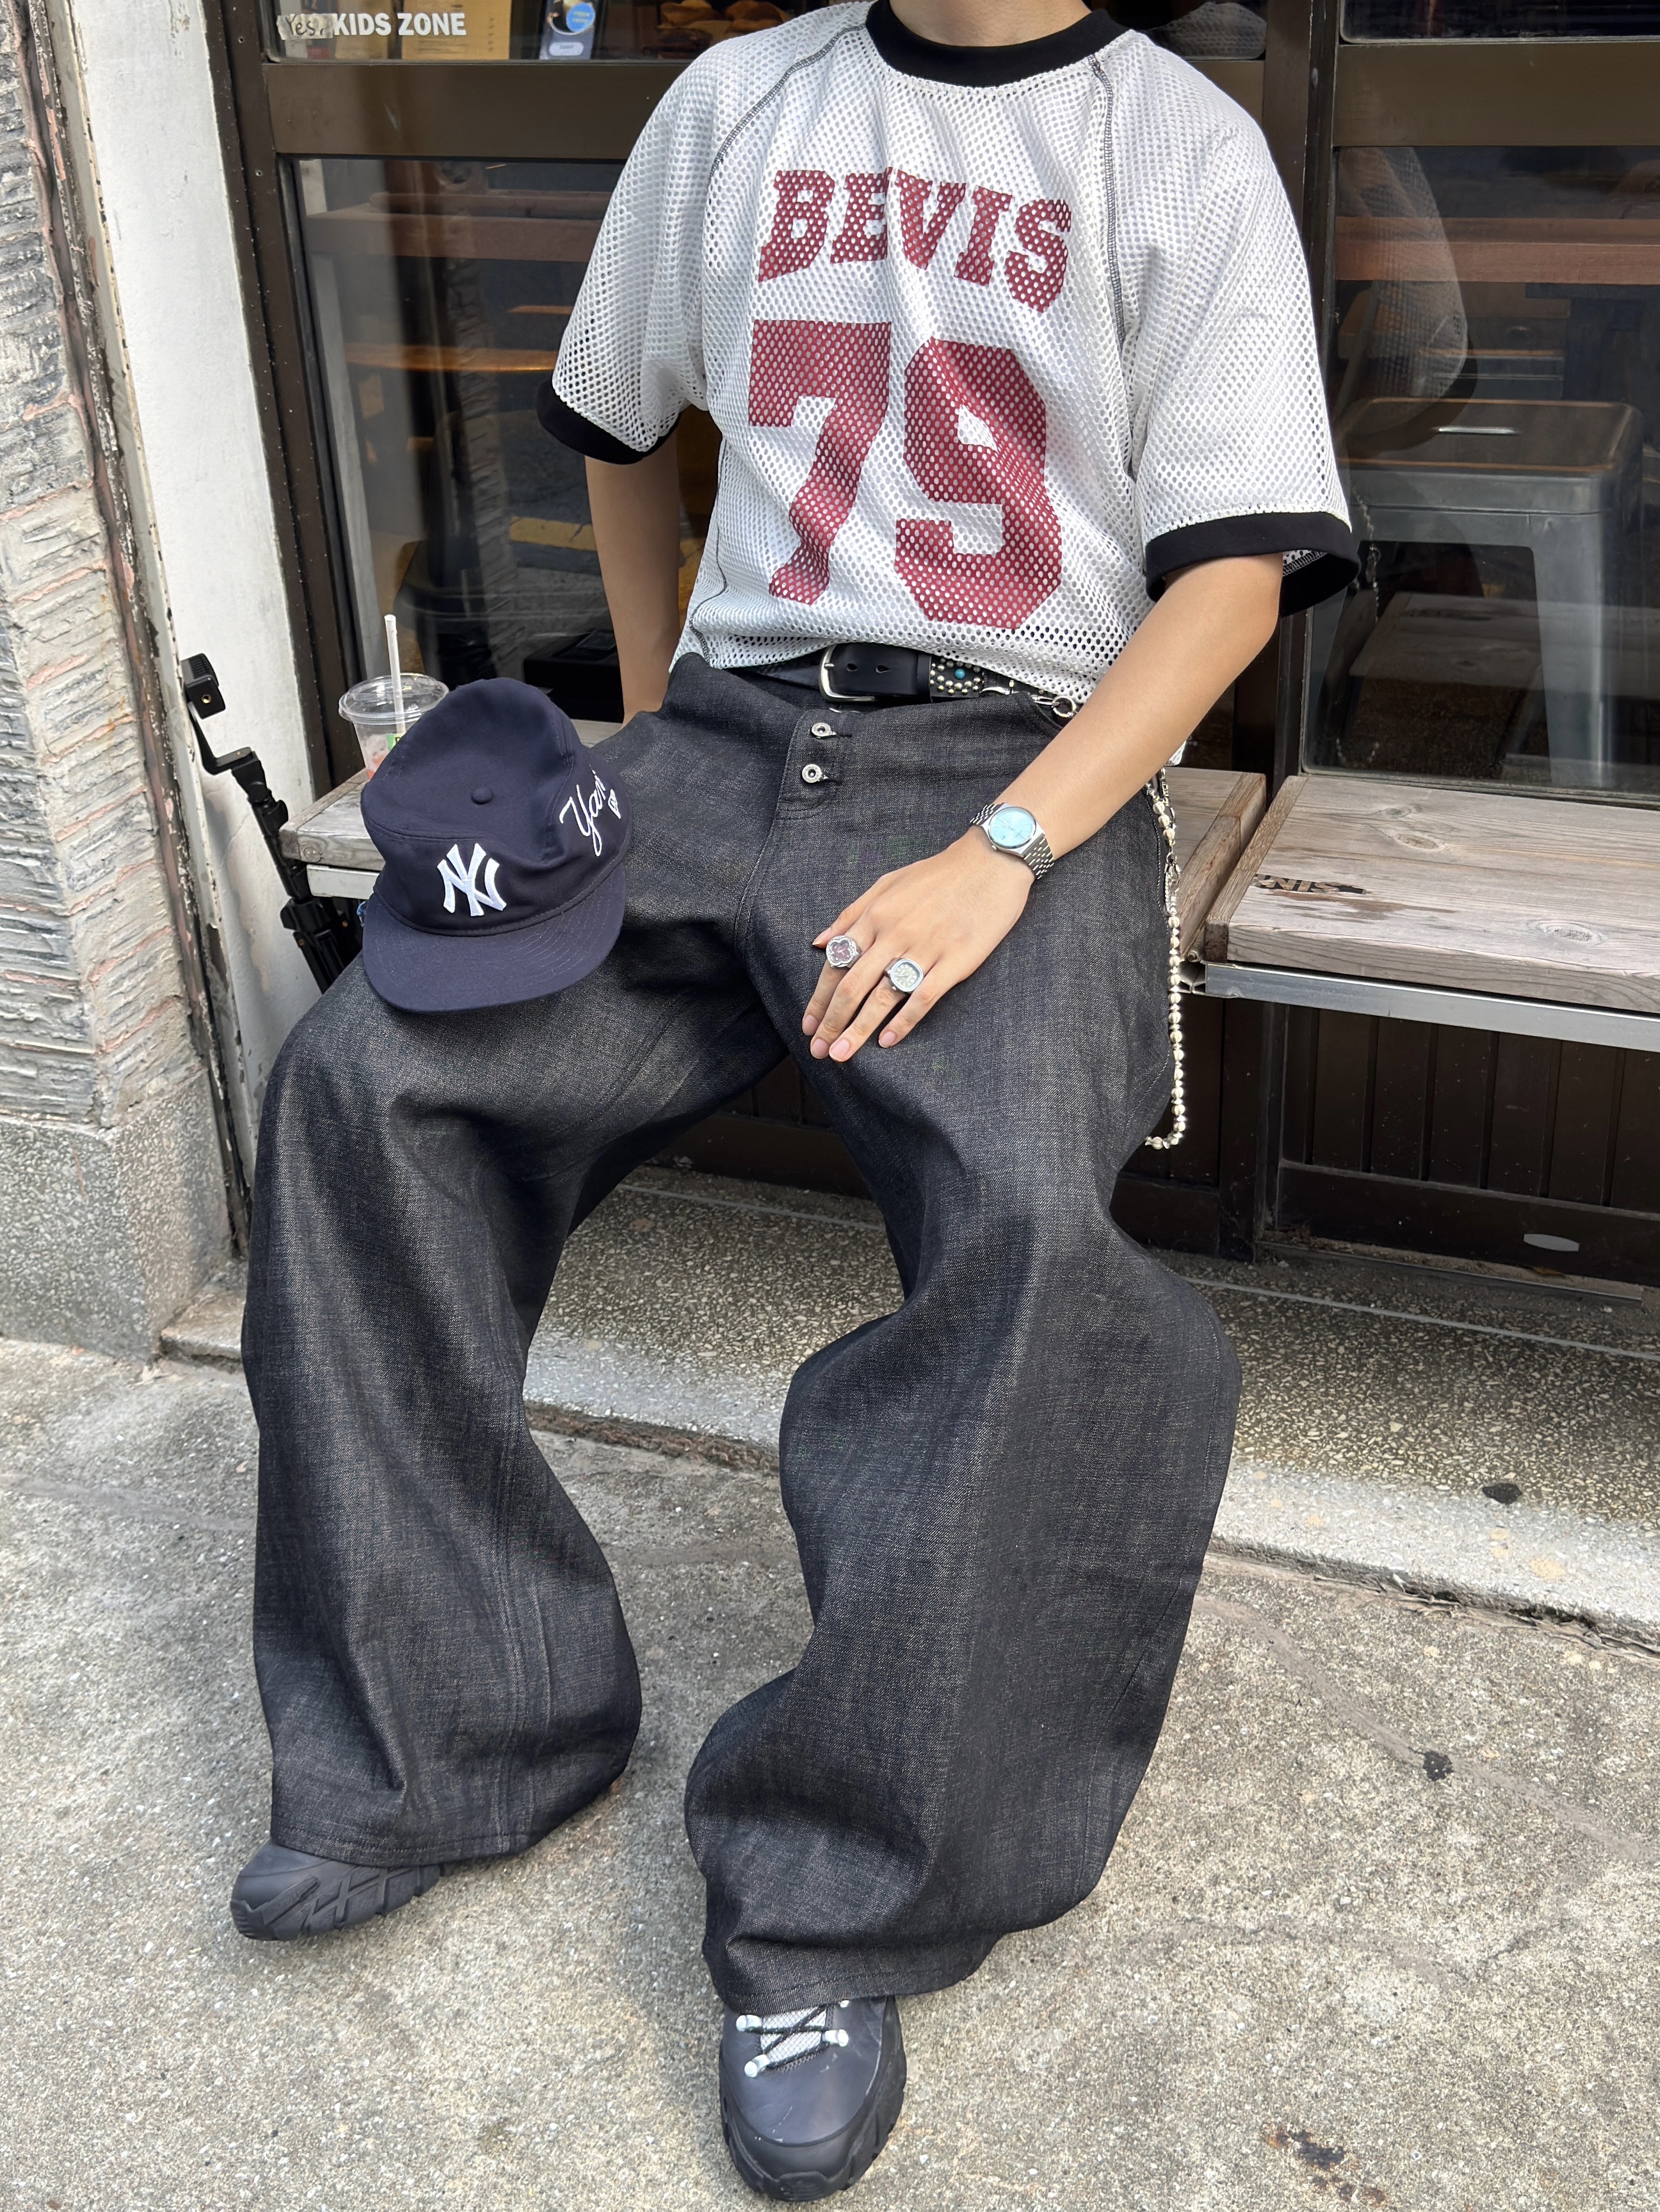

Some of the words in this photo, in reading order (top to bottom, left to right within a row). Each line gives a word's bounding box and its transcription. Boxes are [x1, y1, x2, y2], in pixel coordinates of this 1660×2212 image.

[334, 12, 392, 36] KIDS
[396, 12, 467, 36] ZONE
[757, 167, 1072, 313] BEVIS
[748, 319, 1063, 630] 79
[436, 842, 507, 917] NY
